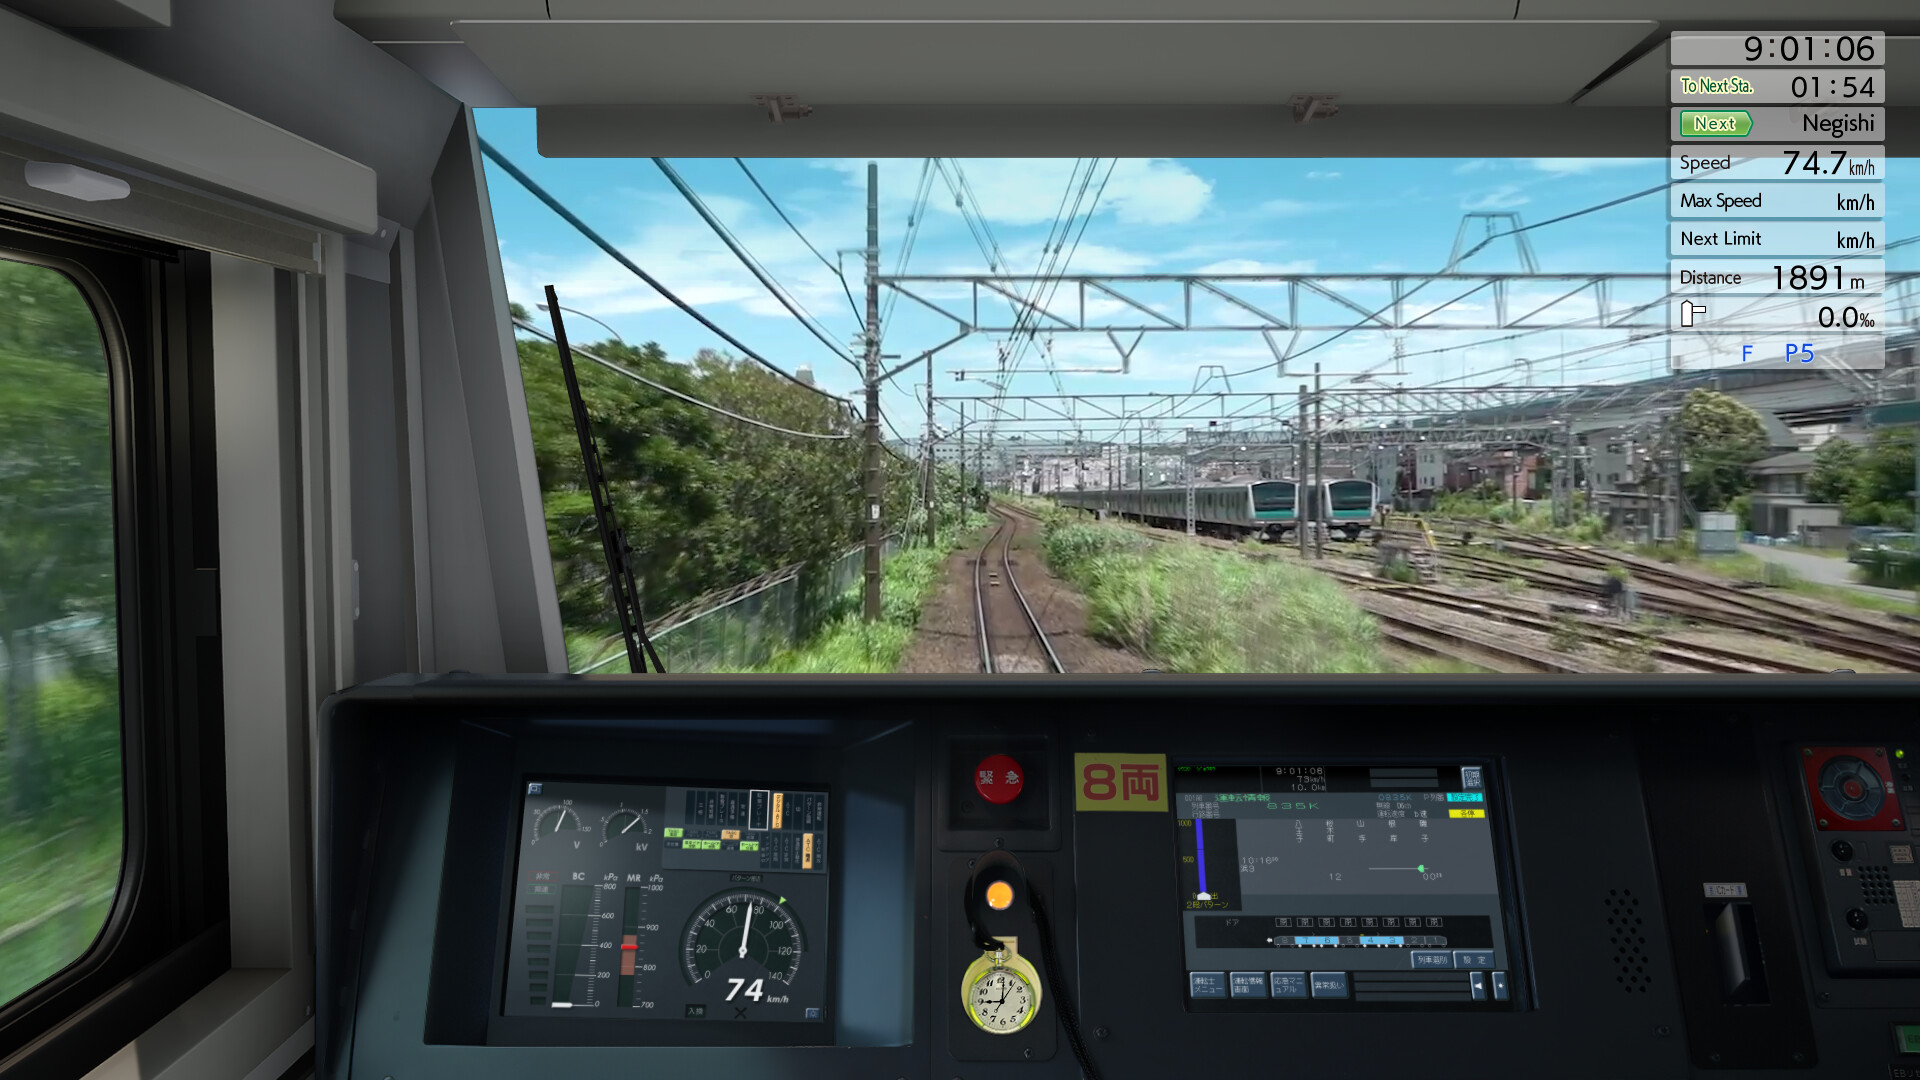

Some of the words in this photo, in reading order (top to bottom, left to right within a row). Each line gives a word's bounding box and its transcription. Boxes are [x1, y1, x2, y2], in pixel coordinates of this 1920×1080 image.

[979, 770, 1020, 785] 緊急
[1083, 763, 1159, 801] 8両
[573, 841, 581, 849] V
[635, 843, 649, 851] kV
[572, 872, 586, 881] BC
[603, 873, 619, 881] kPa
[626, 874, 641, 882] MR
[1329, 873, 1342, 881] 12
[725, 905, 738, 914] 60
[753, 905, 765, 915] 80
[704, 919, 715, 928] 40
[769, 920, 784, 930] 100
[696, 945, 707, 954] 20
[778, 946, 793, 956] 120
[704, 971, 711, 979] 0
[768, 971, 783, 980] 140
[725, 978, 764, 1002] 74
[1194, 986, 1223, 994] メニュー
[766, 995, 789, 1004] km/h
